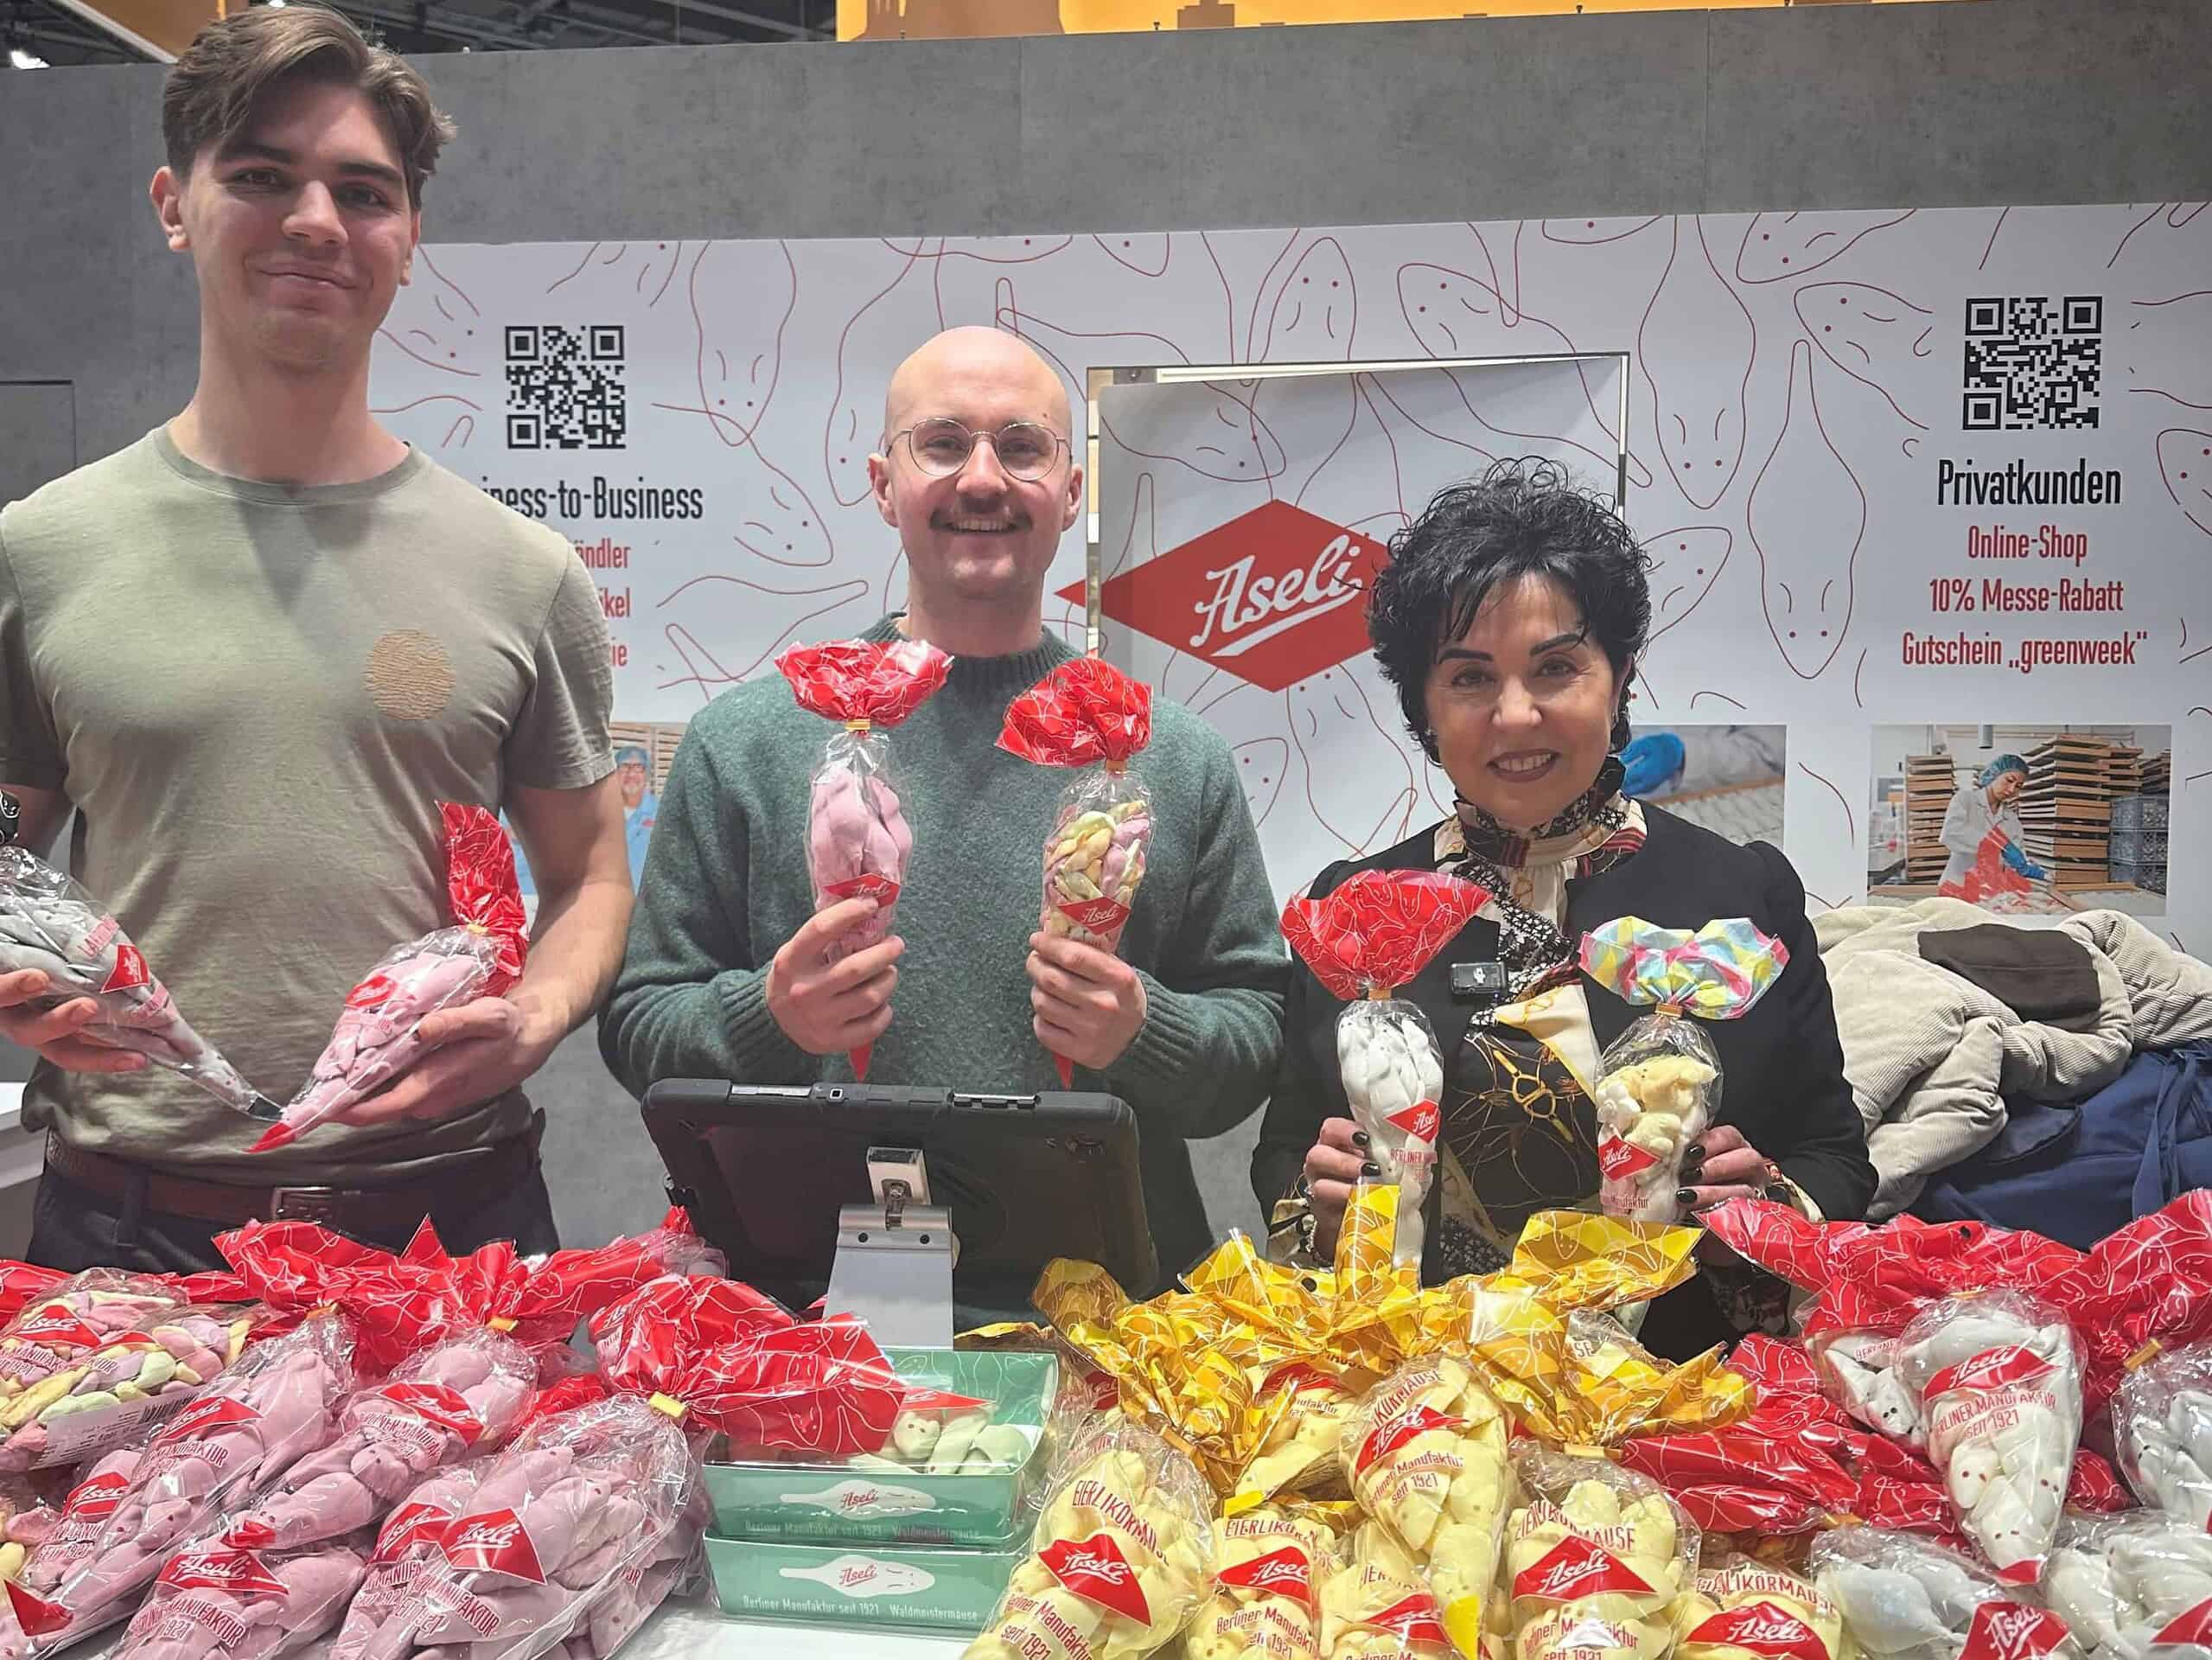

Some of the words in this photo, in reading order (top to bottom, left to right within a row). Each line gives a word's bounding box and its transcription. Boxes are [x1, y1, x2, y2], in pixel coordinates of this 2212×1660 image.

[1938, 459, 2121, 505] Privatkunden
[574, 538, 631, 569] ändler
[1968, 526, 2088, 567] Online-Shop
[1189, 534, 1363, 657] Aseli
[1930, 579, 1975, 611] 10%
[1982, 578, 2124, 611] Messe-Rabatt
[1903, 631, 2002, 665] Gutschein
[1949, 1346, 2015, 1388] Aseli
[1992, 1408, 2019, 1427] 1921
[841, 1489, 879, 1510] Aseli
[839, 1563, 877, 1587] Aseli
[1537, 1548, 1611, 1594] Aseli
[839, 1601, 857, 1614] seit
[859, 1603, 879, 1615] 1921
[1216, 1610, 1260, 1634] Berliner
[1726, 1617, 1807, 1644] Aseli
